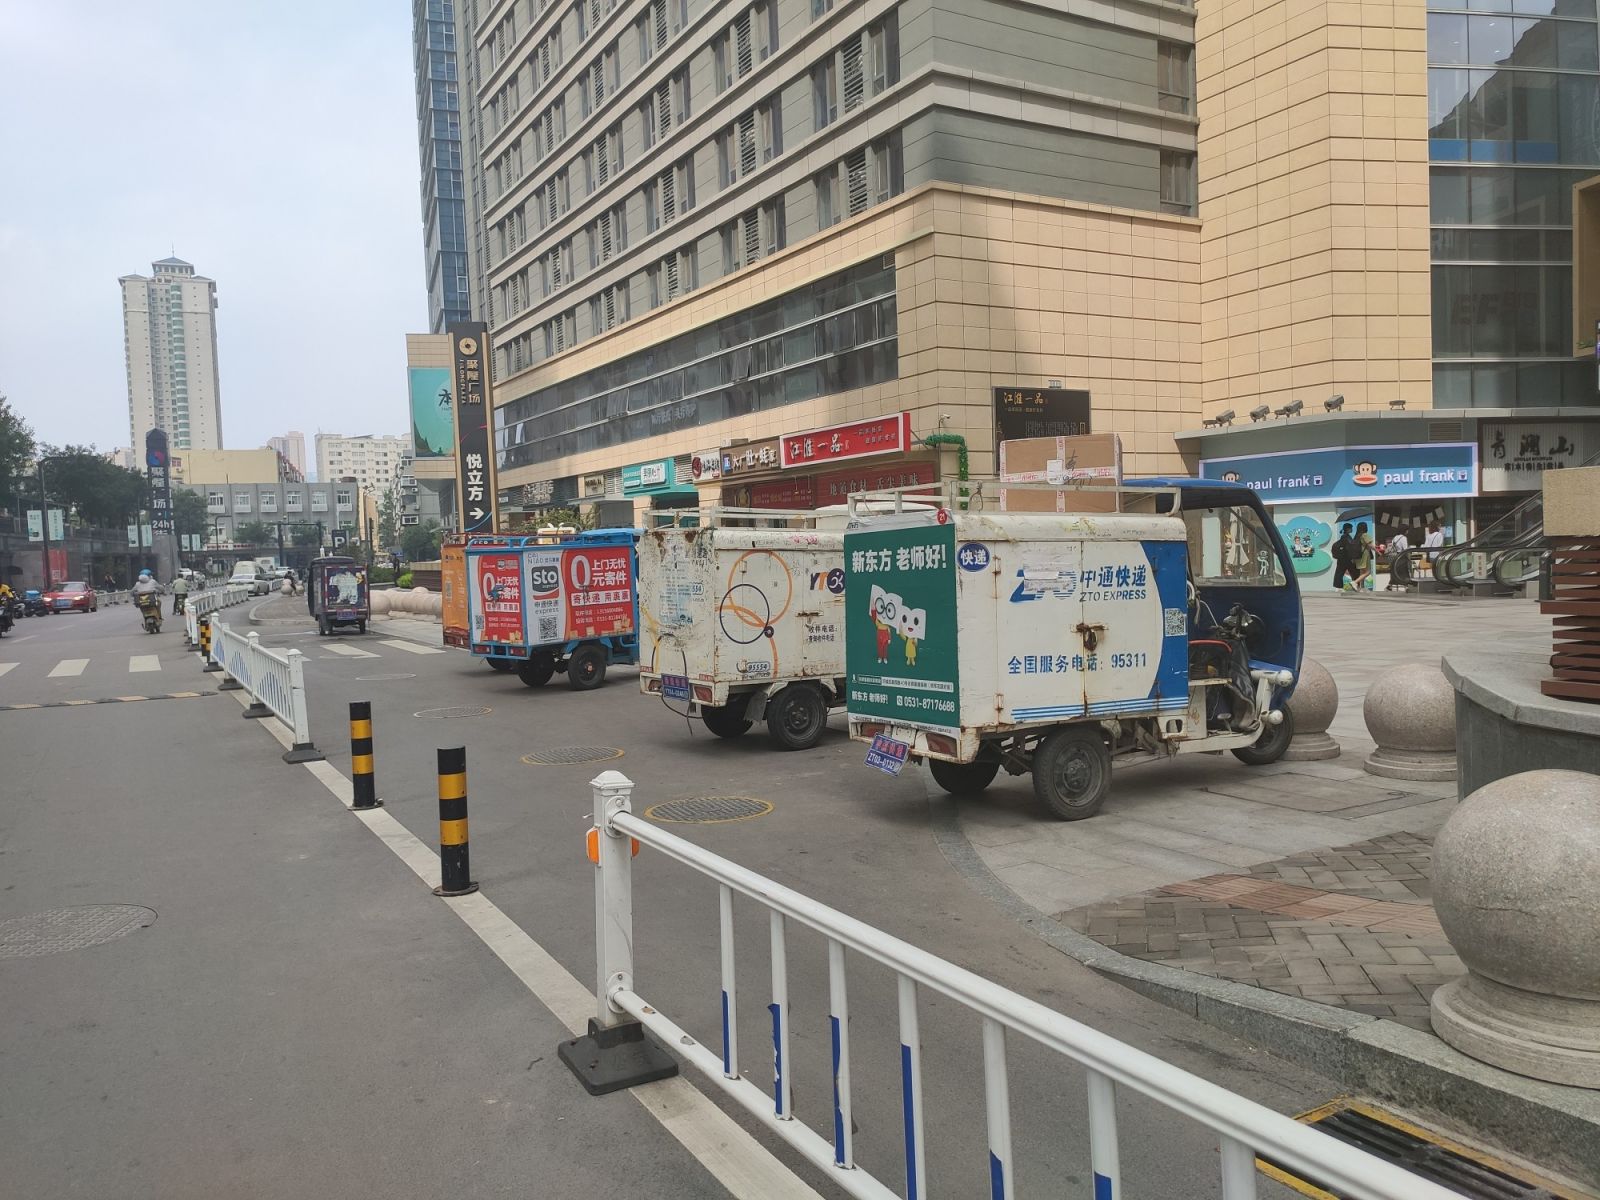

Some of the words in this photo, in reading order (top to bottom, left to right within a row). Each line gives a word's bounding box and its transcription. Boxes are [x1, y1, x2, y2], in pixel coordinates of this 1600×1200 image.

[466, 453, 484, 501] 悦立方
[1246, 477, 1273, 491] paul
[1277, 475, 1310, 488] frank
[1383, 470, 1414, 487] paul
[1419, 469, 1455, 483] frank
[152, 520, 170, 529] 24h
[334, 536, 346, 548] P
[591, 558, 627, 571] 上门无忧
[852, 548, 893, 574] 新东方
[960, 549, 987, 566] 快递
[533, 568, 558, 585] sto
[592, 570, 628, 587] 元寄件
[1080, 564, 1147, 589] 中通快递
[1079, 591, 1101, 603] ZTO
[1103, 589, 1147, 601] EXPRESS
[535, 607, 560, 616] express
[1110, 652, 1147, 669] 95311
[852, 690, 868, 702] 新东方
[903, 696, 956, 713] 0531-87176688
